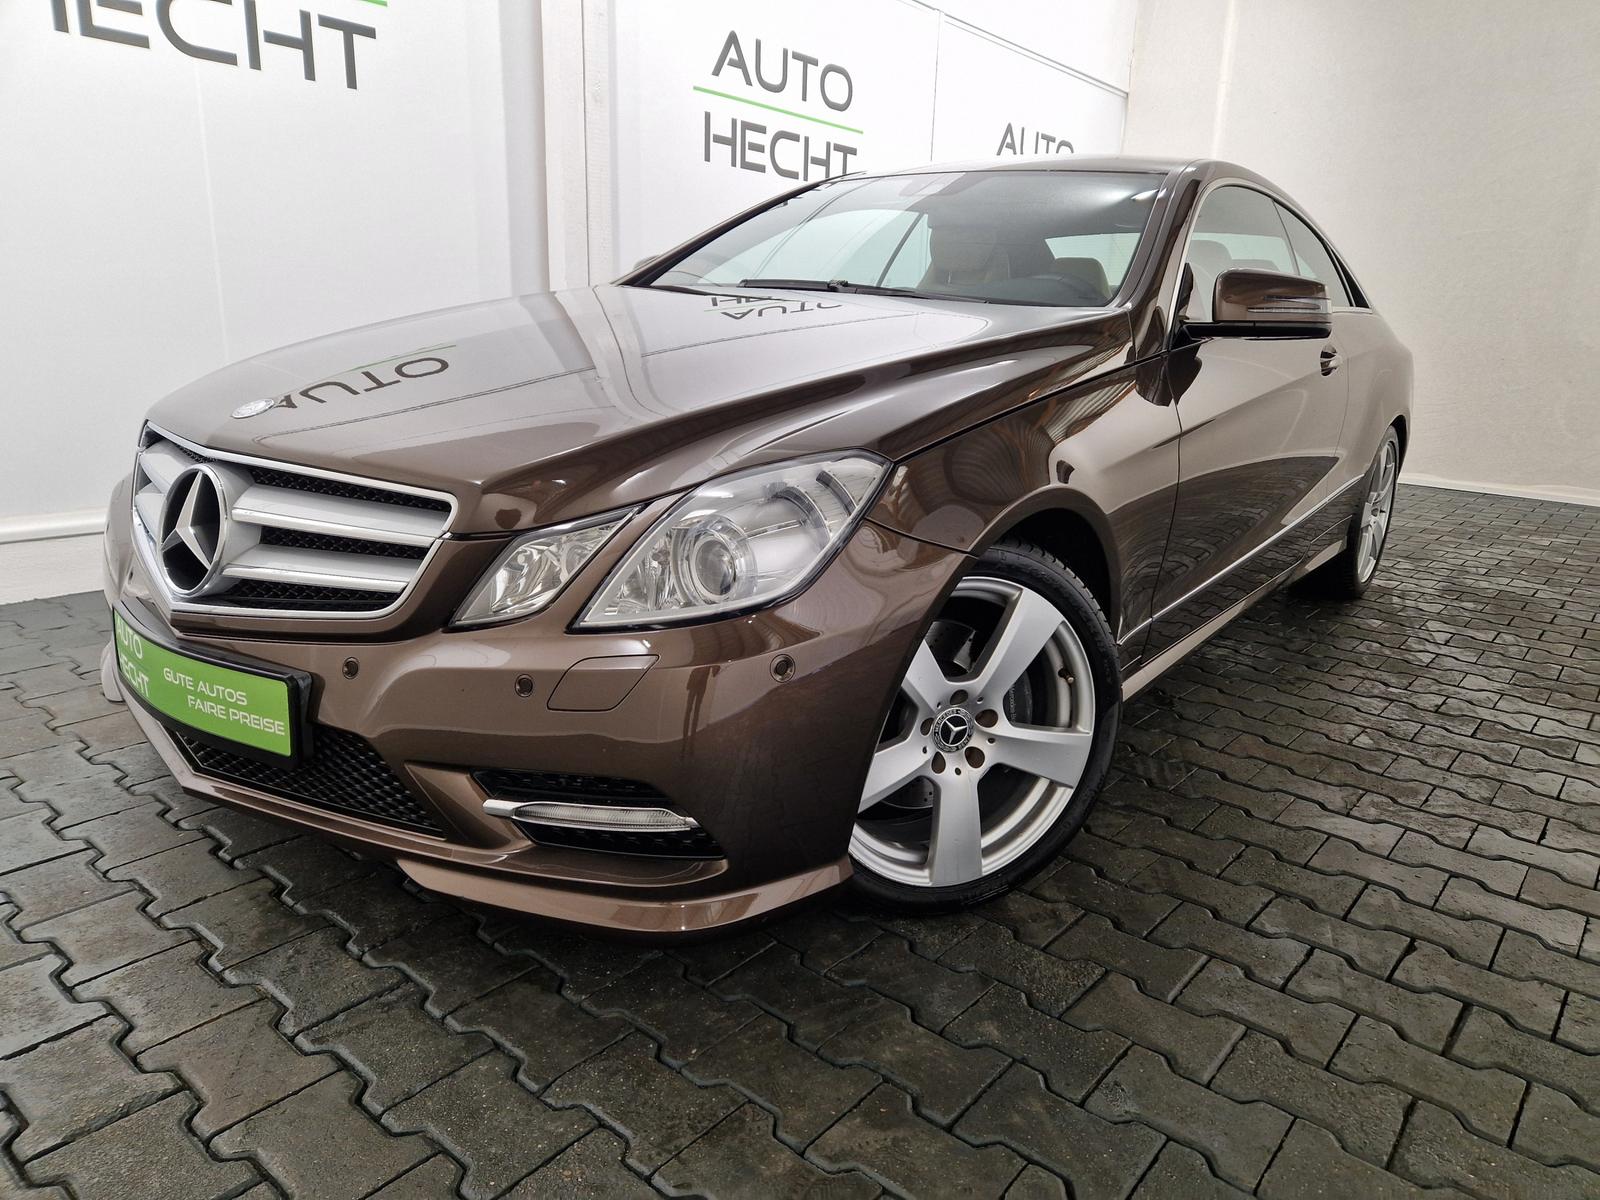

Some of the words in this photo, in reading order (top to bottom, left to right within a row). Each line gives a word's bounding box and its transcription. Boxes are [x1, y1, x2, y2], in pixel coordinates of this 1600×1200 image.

[50, 0, 377, 90] ECHT
[711, 30, 853, 112] AUTO
[704, 111, 858, 182] HECHT
[114, 611, 143, 659] AUTO
[163, 667, 194, 690] GUTE
[197, 681, 247, 706] AUTOS
[187, 695, 227, 719] FAIRE
[229, 708, 285, 736] PREISE
